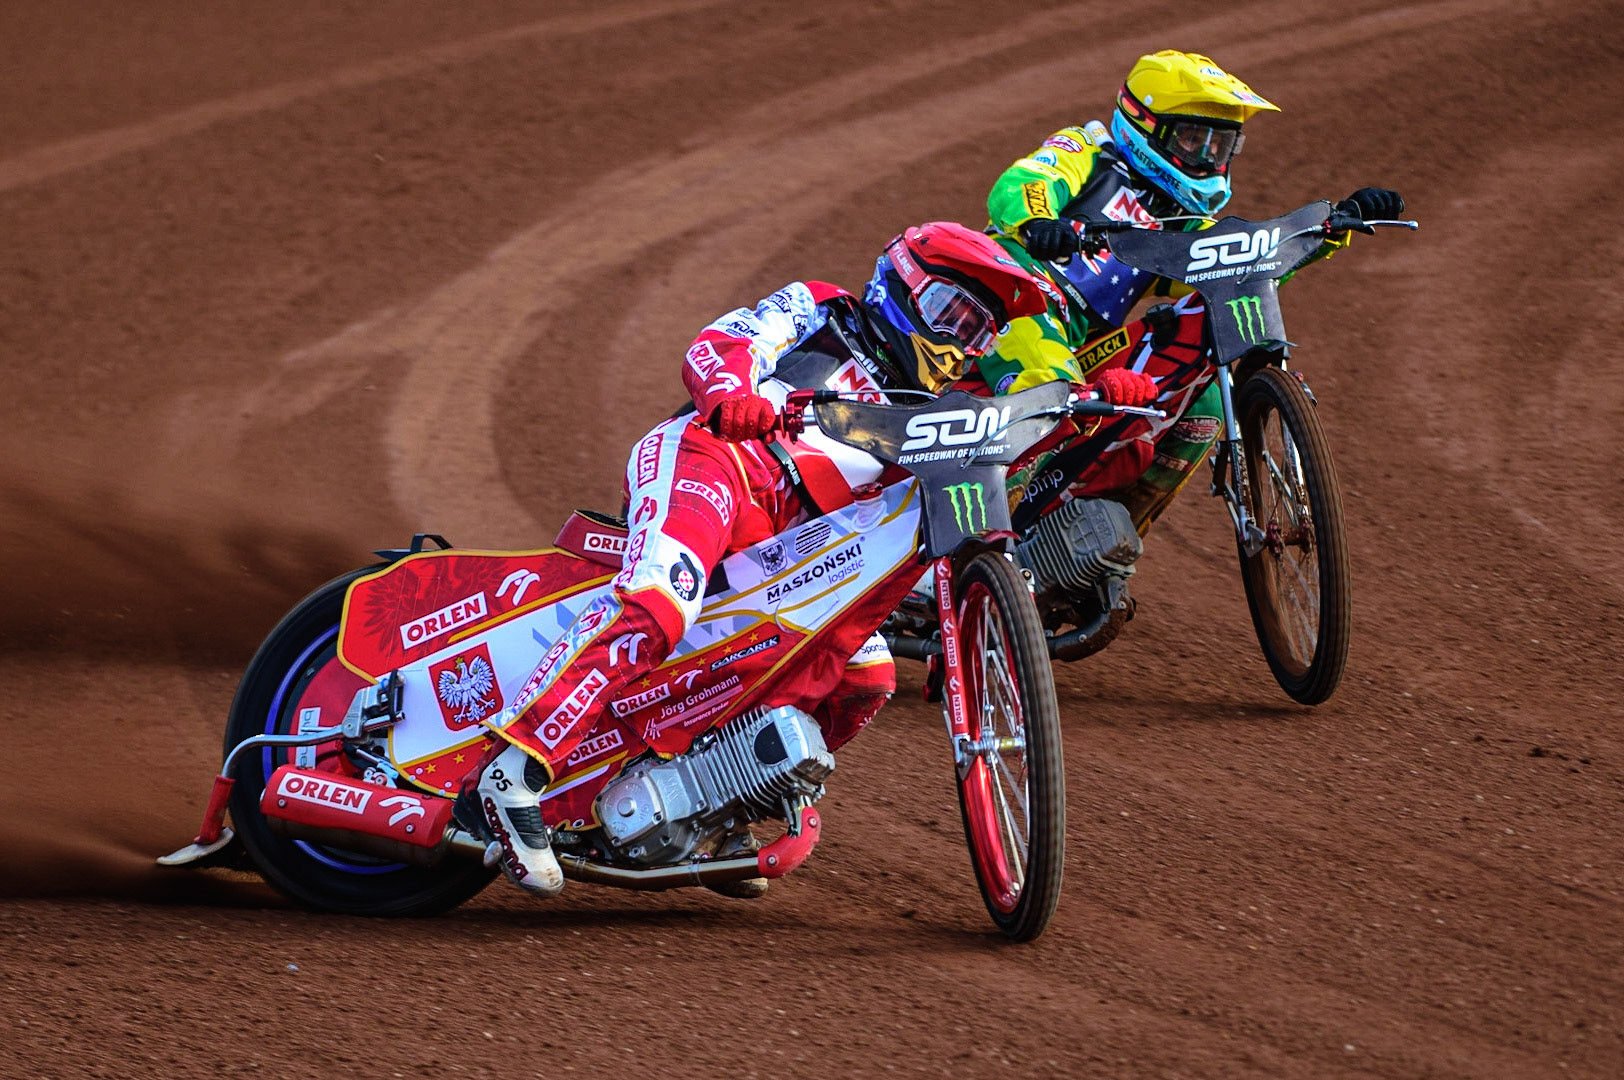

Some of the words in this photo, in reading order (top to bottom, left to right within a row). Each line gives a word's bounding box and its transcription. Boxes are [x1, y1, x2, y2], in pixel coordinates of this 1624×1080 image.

[1185, 274, 1198, 284] FIM
[1199, 268, 1236, 281] SPEEDWAY
[1236, 267, 1246, 275] OF
[1079, 335, 1121, 370] TRACK
[639, 435, 660, 485] ORLEN
[785, 457, 801, 485] POLAND
[898, 454, 914, 465] FIM
[914, 450, 957, 463] SPEEDWAY
[957, 448, 969, 459] OF
[681, 482, 729, 523] ORLEN
[767, 543, 862, 604] MASZOŃSKI
[828, 558, 866, 585] logistic
[673, 581, 690, 600] PZM
[941, 581, 950, 608] ORLEN
[407, 598, 481, 642] ORLEN
[947, 638, 957, 666] ORLEN
[543, 675, 603, 741] ORLEN
[616, 685, 667, 714] ORLEN
[660, 703, 685, 719] Jörg
[685, 675, 740, 707] Grohmann
[954, 695, 963, 723] ORLEN
[683, 711, 712, 728] Insurance
[569, 733, 619, 762] ORLEN
[286, 777, 365, 810] ORLEN
